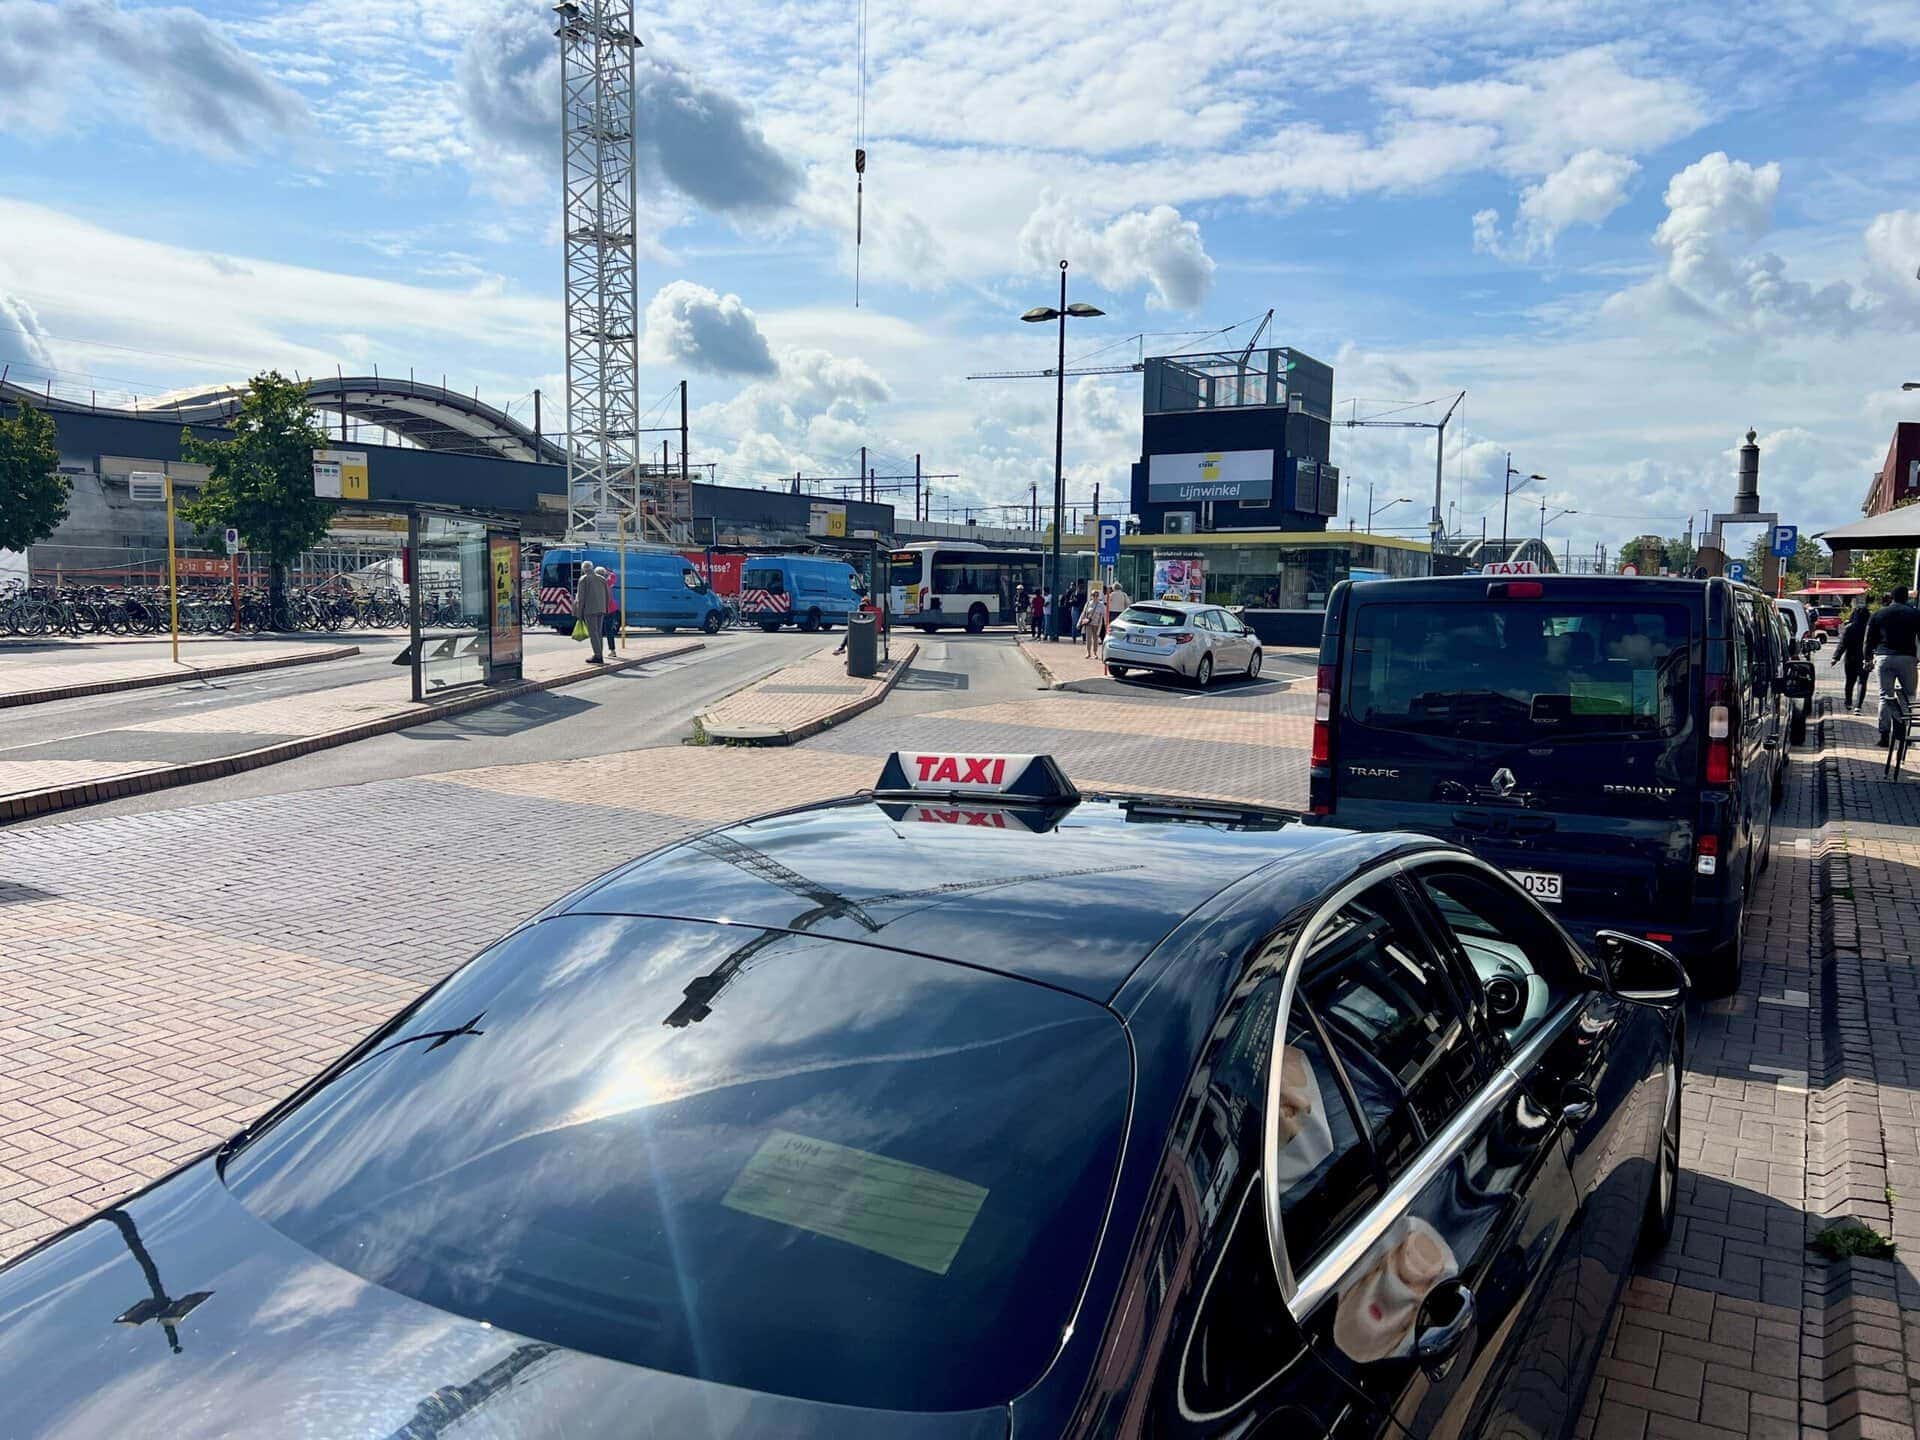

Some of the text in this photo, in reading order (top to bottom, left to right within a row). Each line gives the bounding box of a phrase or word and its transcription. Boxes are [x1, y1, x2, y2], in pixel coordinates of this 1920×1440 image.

[348, 476, 360, 489] 11
[1180, 484, 1240, 500] Lijnwinkel
[832, 520, 842, 529] 10
[1101, 525, 1117, 549] P
[1775, 528, 1793, 550] P
[1488, 562, 1531, 575] TAXI
[1731, 565, 1742, 578] P
[916, 756, 1006, 785] TAXI
[1349, 766, 1400, 778] TRAFIC
[1603, 784, 1677, 796] RENAULT
[1524, 875, 1559, 895] 035
